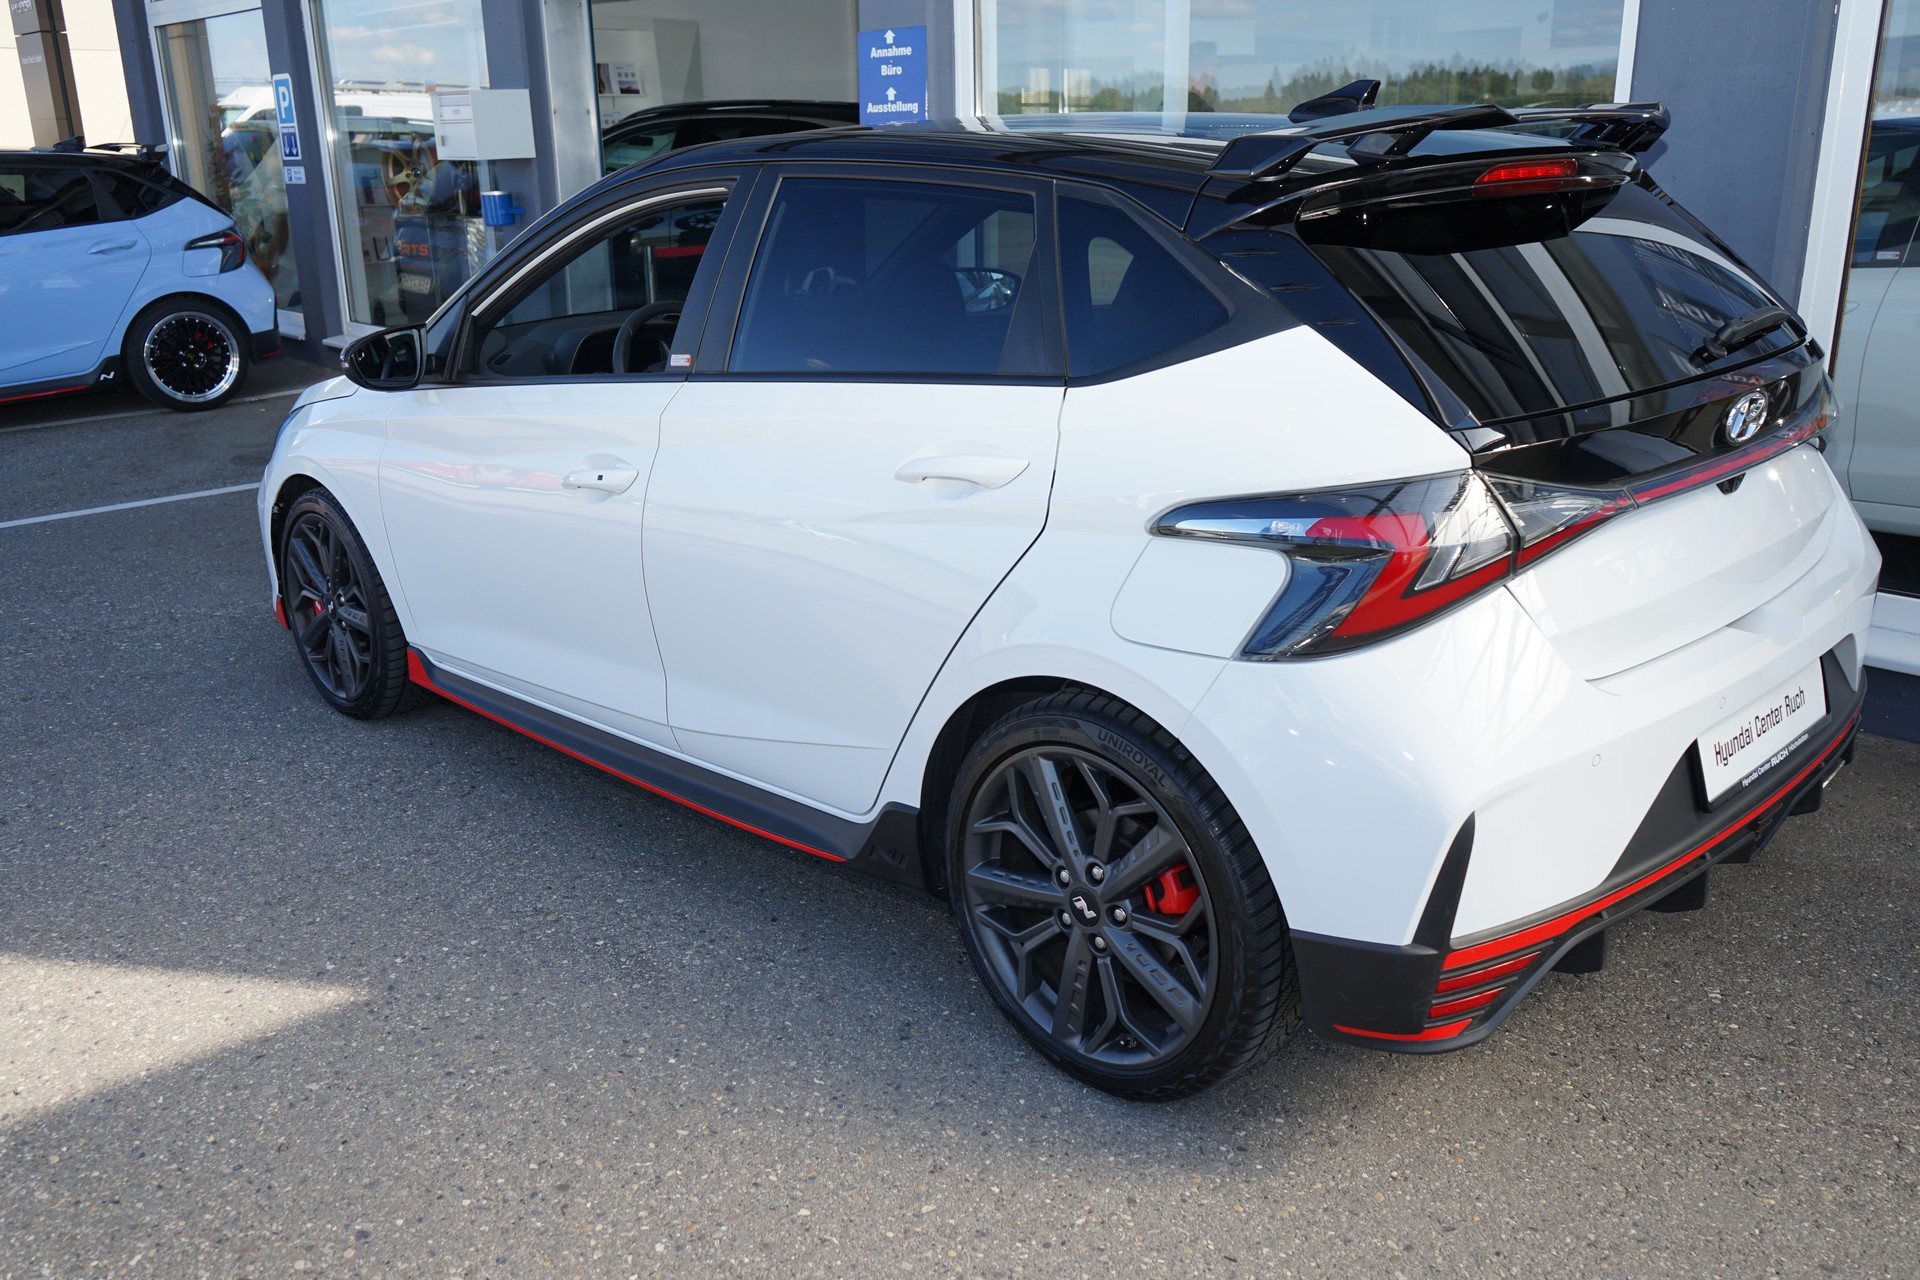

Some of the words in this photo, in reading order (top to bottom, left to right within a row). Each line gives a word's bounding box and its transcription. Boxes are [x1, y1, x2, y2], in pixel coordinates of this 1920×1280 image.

[870, 45, 913, 59] Annahme
[881, 64, 903, 76] Büro
[278, 85, 290, 120] P
[866, 101, 919, 114] Ausstellung
[1713, 721, 1754, 767] Hyundai
[1754, 704, 1783, 738] Center
[1784, 686, 1806, 717] Ruch
[1096, 728, 1167, 788] UNIROYAL
[1741, 771, 1759, 787] Hyundai
[1757, 761, 1772, 775] Center
[1770, 747, 1789, 767] RUCH
